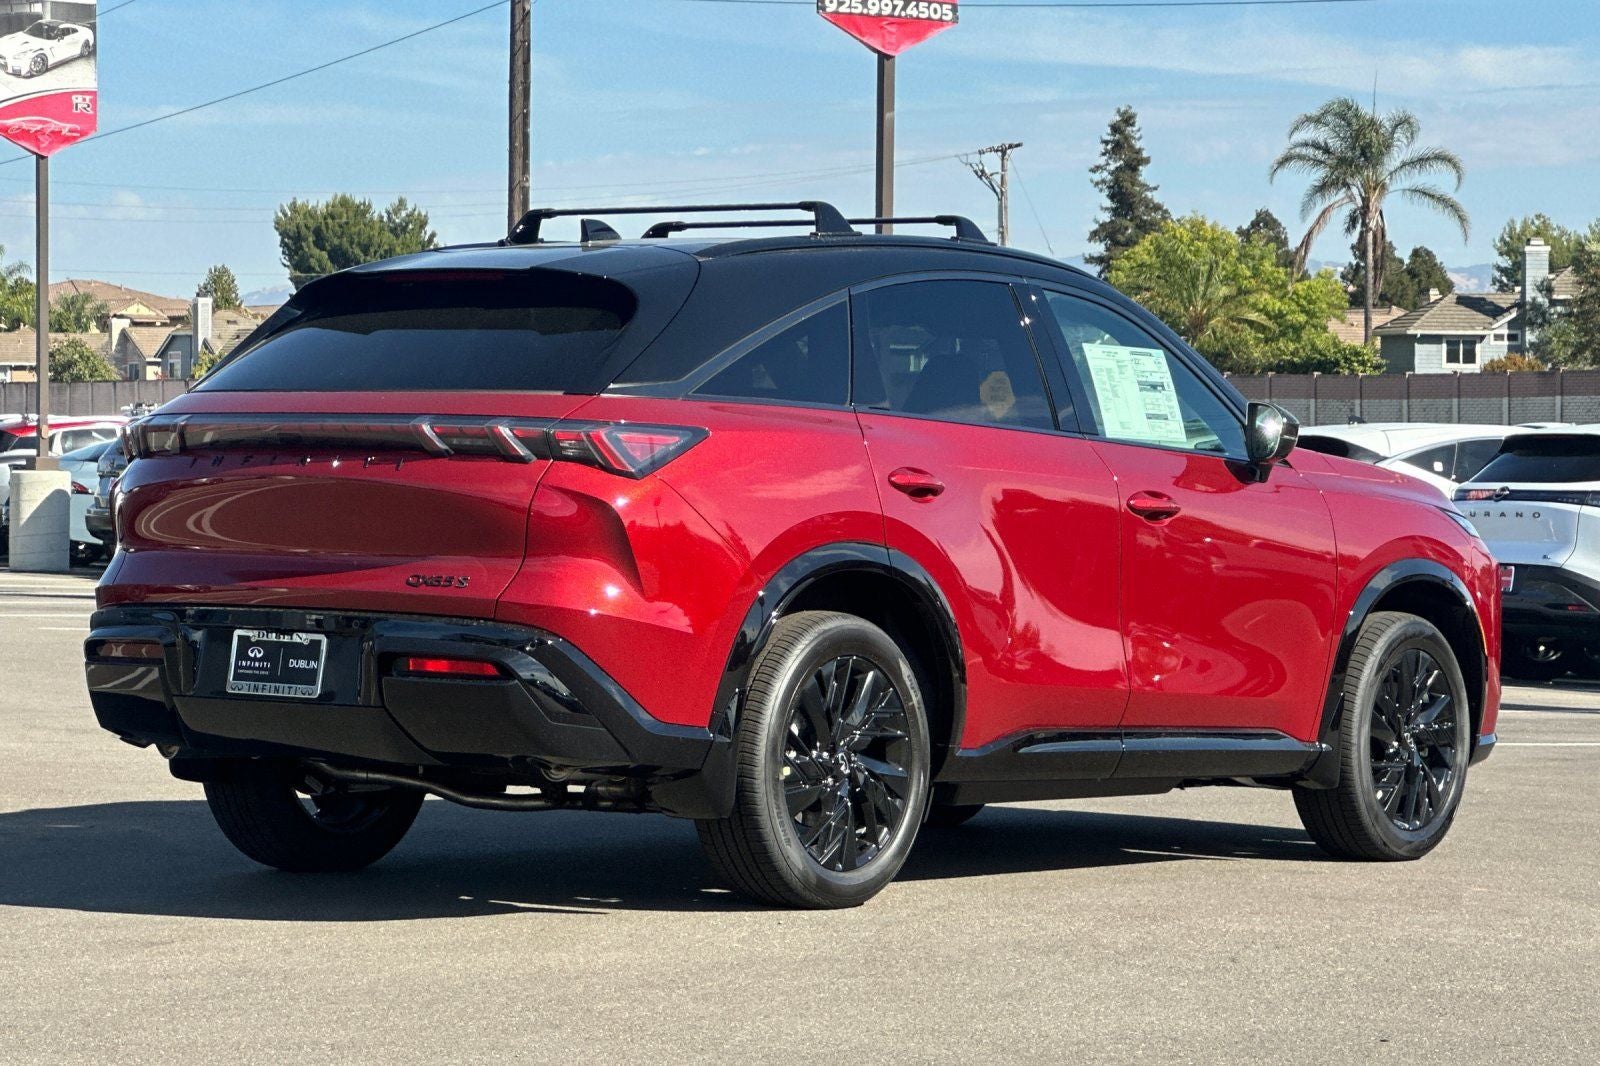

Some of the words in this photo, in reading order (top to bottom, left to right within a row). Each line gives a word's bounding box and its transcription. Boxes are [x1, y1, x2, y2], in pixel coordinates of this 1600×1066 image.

[825, 0, 953, 21] 925.997.4505
[238, 660, 271, 668] INFINITI
[288, 658, 318, 669] DUBLIN
[248, 683, 298, 695] INFINITI
